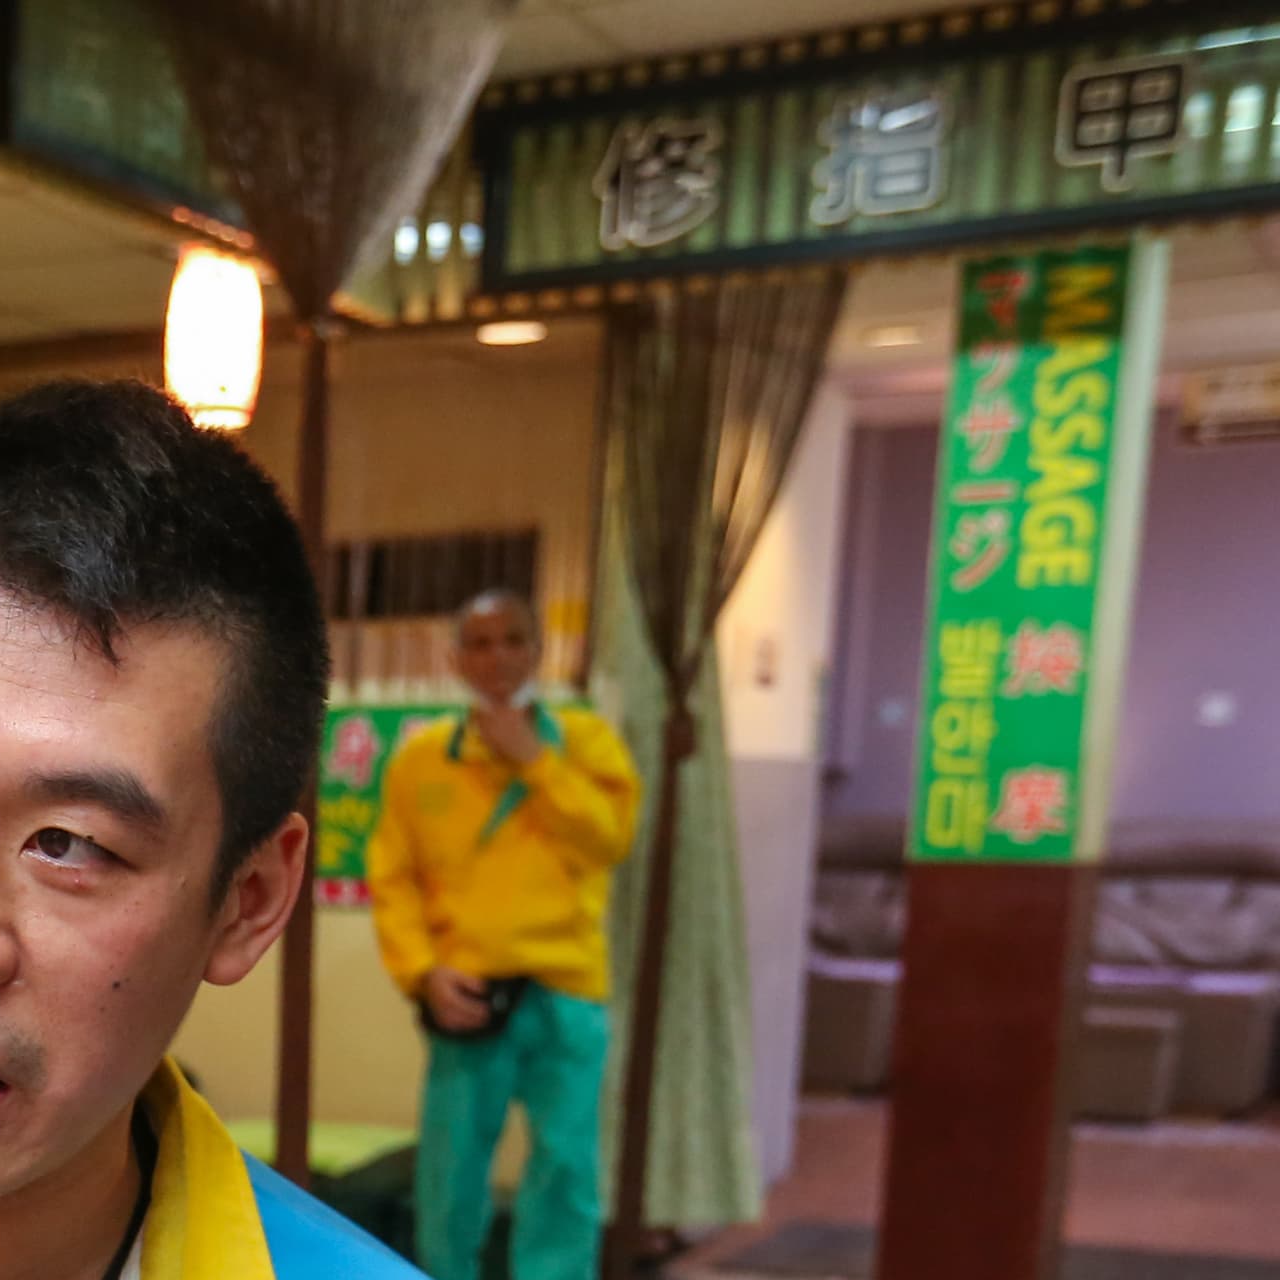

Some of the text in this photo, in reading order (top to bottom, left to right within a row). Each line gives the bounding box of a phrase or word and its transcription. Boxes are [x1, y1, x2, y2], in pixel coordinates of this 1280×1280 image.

[594, 55, 1194, 251] 修指甲
[1015, 264, 1115, 590] MASSAGE
[993, 617, 1085, 845] 按摩
